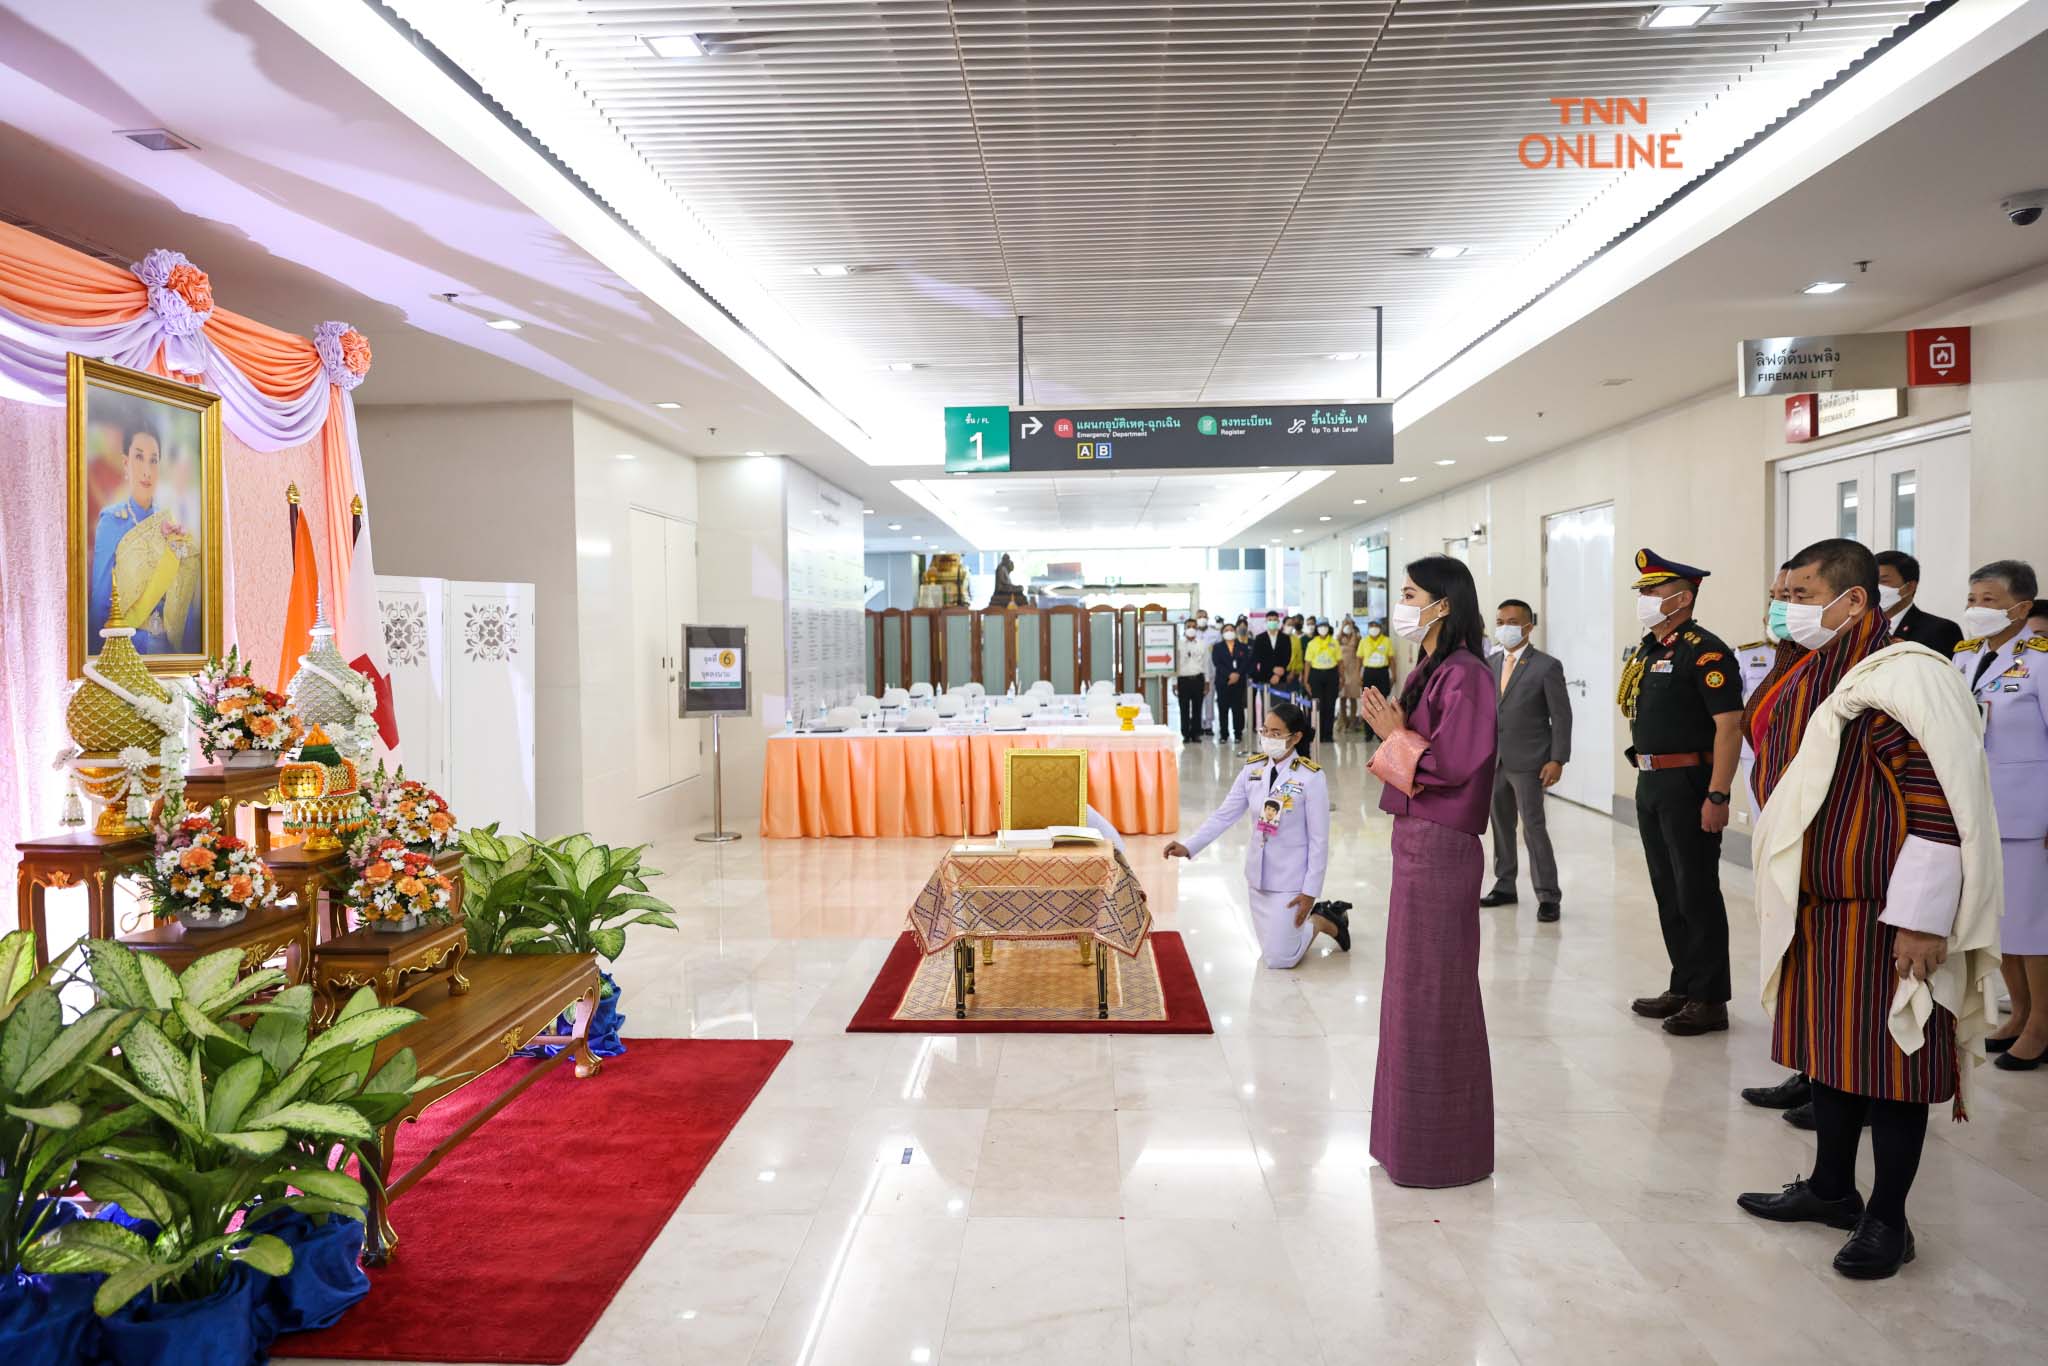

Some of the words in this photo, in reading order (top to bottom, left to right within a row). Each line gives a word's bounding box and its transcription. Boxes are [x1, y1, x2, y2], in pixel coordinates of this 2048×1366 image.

[1755, 347, 1841, 367] ลิฟต์ดับเพลิง
[1758, 371, 1808, 382] FIREMAN
[1811, 369, 1834, 379] LIFT
[1221, 414, 1272, 427] ลงทะเบียน
[1357, 414, 1368, 424] M
[1058, 424, 1069, 432] ER
[969, 431, 983, 464] 1
[1080, 446, 1090, 456] A
[1099, 445, 1109, 456] B
[723, 653, 731, 665] 6
